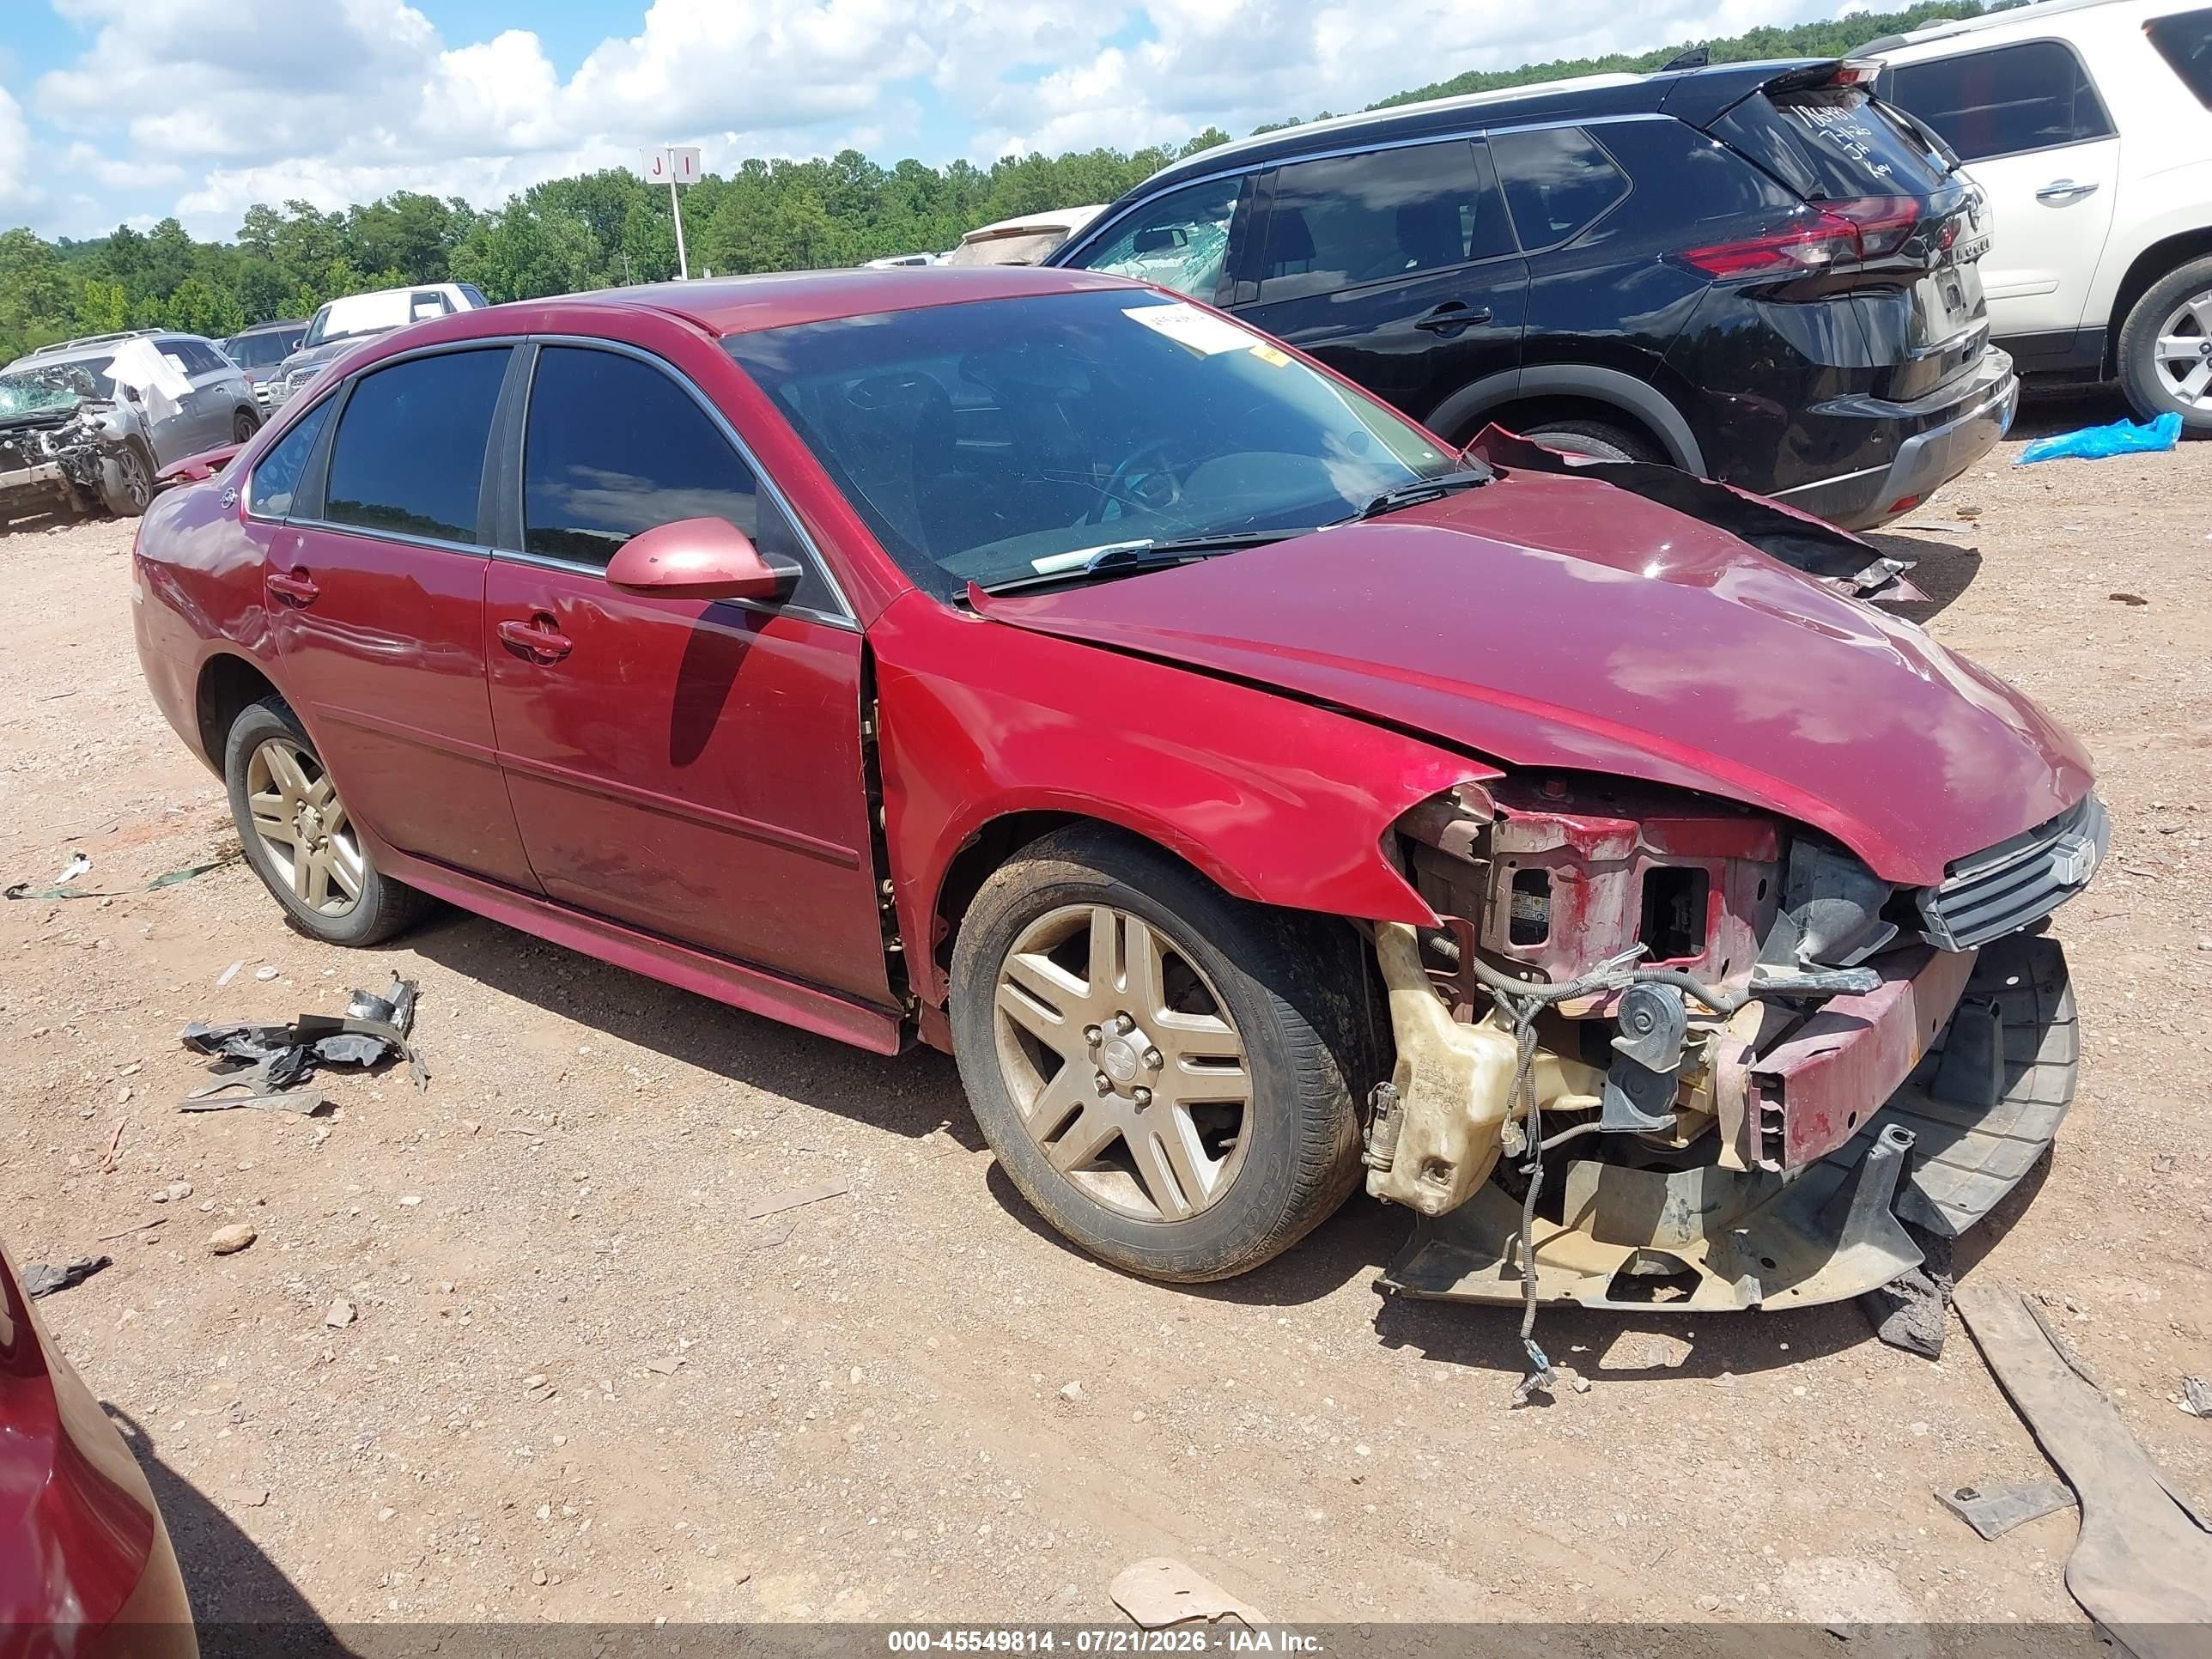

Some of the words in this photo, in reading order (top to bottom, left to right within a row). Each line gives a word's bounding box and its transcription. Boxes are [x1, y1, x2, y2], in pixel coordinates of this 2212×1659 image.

[1843, 142, 1870, 161] JH
[653, 156, 661, 175] J
[1863, 161, 1893, 179] Key
